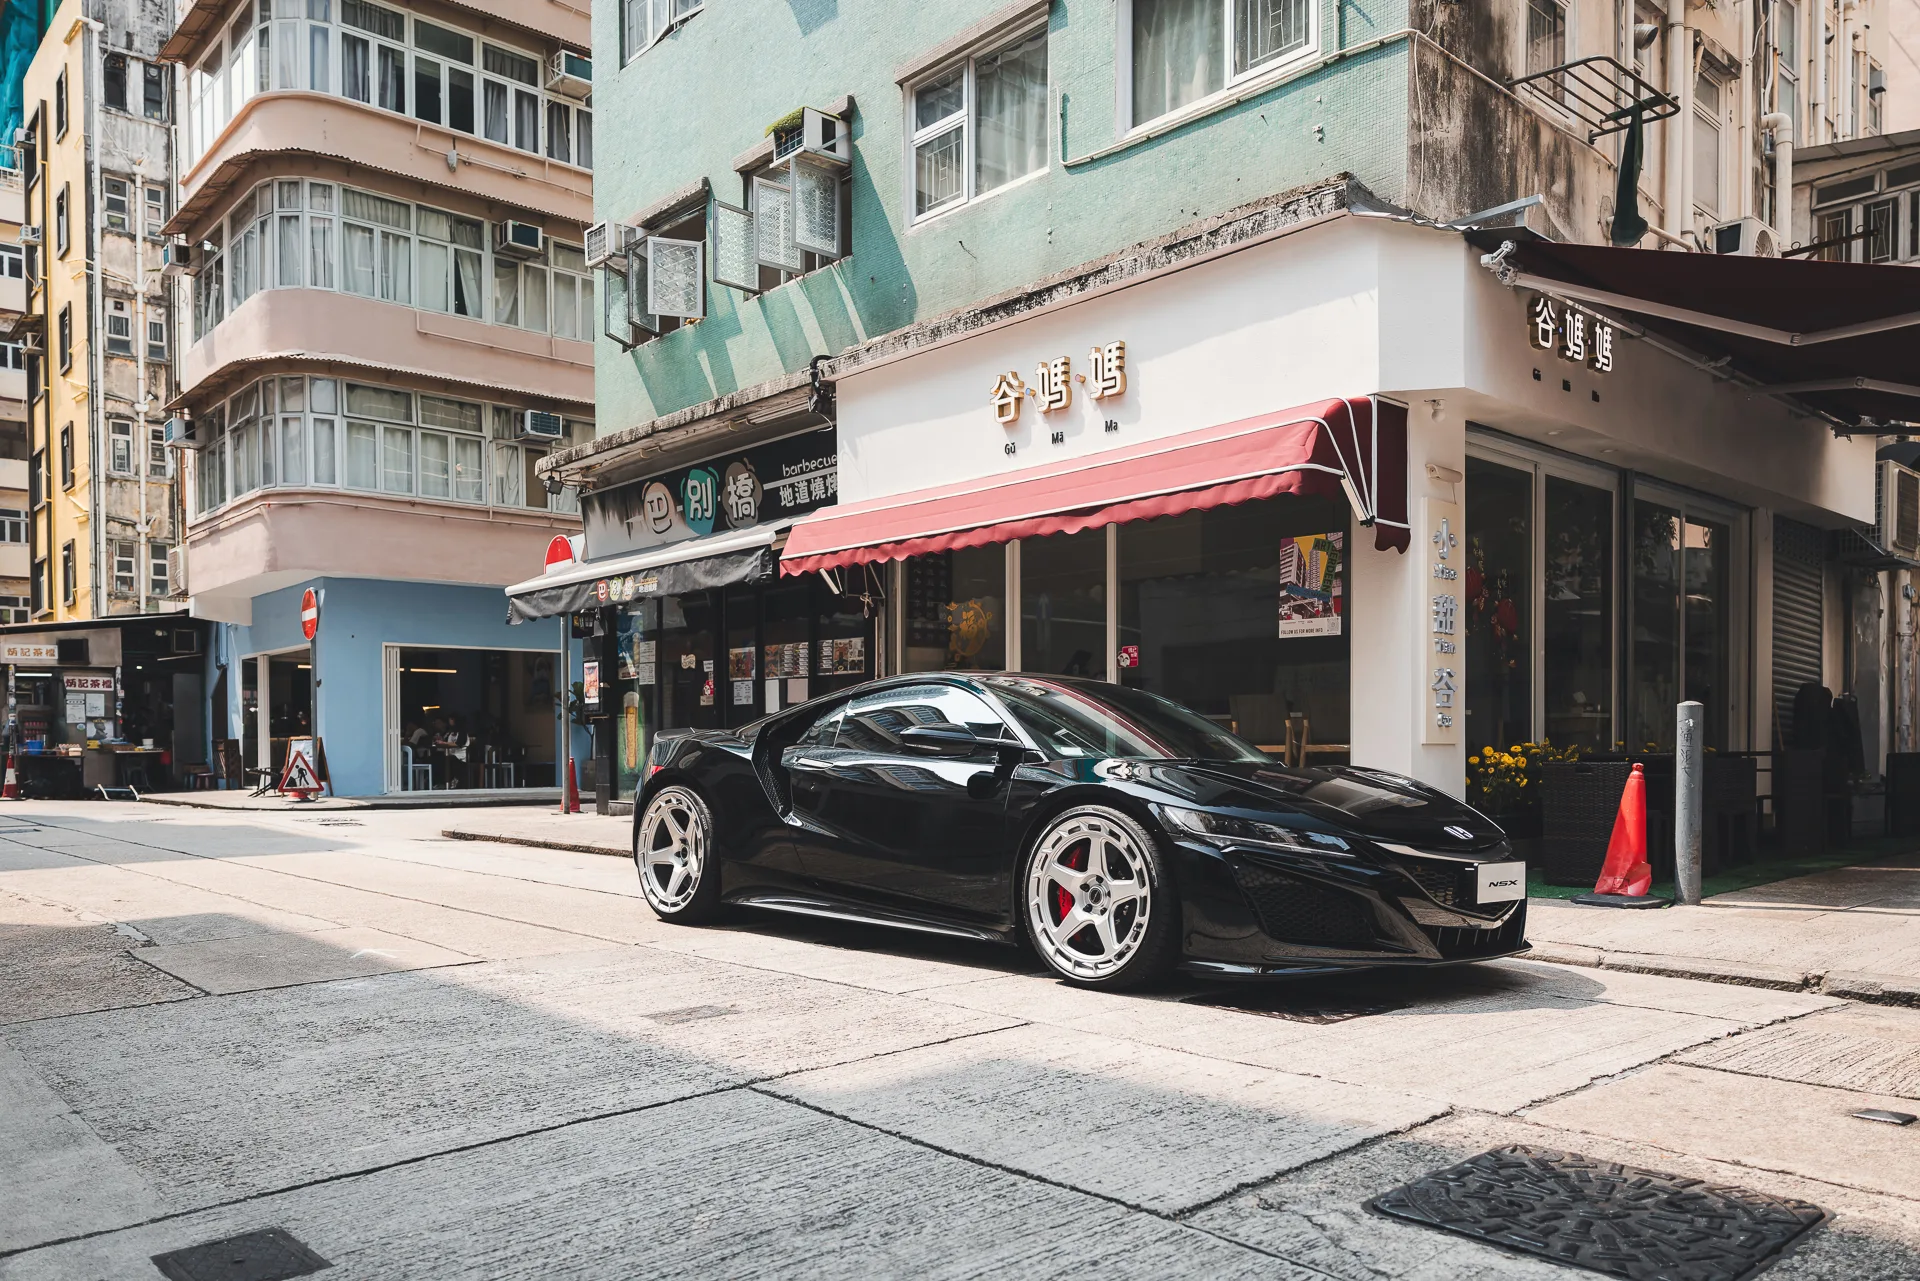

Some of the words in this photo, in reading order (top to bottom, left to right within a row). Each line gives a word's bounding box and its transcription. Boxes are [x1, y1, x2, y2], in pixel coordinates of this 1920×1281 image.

[1536, 297, 1613, 372] 谷媽媽
[990, 340, 1127, 424] 谷媽媽
[1104, 420, 1118, 432] Ma
[782, 454, 837, 477] barbecue
[1488, 880, 1518, 888] NSX
